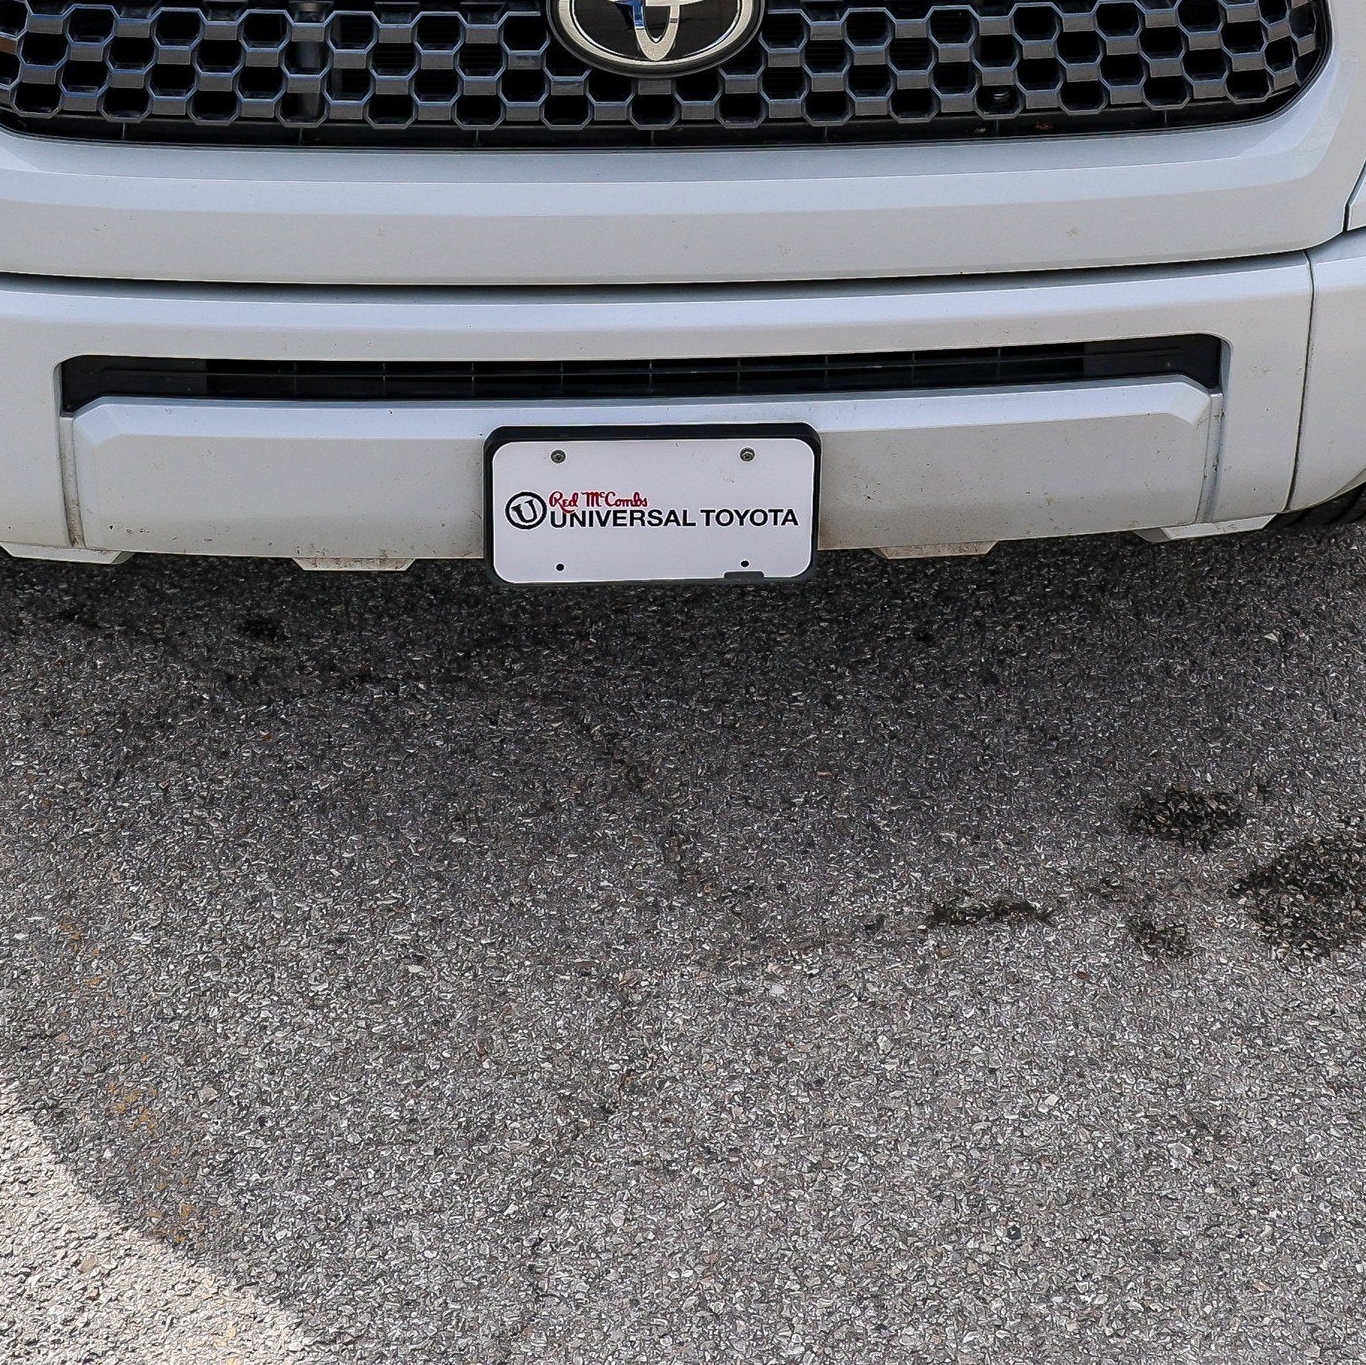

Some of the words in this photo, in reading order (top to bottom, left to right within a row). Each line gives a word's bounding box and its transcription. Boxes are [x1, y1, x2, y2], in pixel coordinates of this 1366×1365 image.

[549, 491, 578, 514] Red
[581, 491, 648, 507] McCombs
[550, 509, 696, 528] UNIVERSAL
[700, 508, 799, 527] TOYOTA
